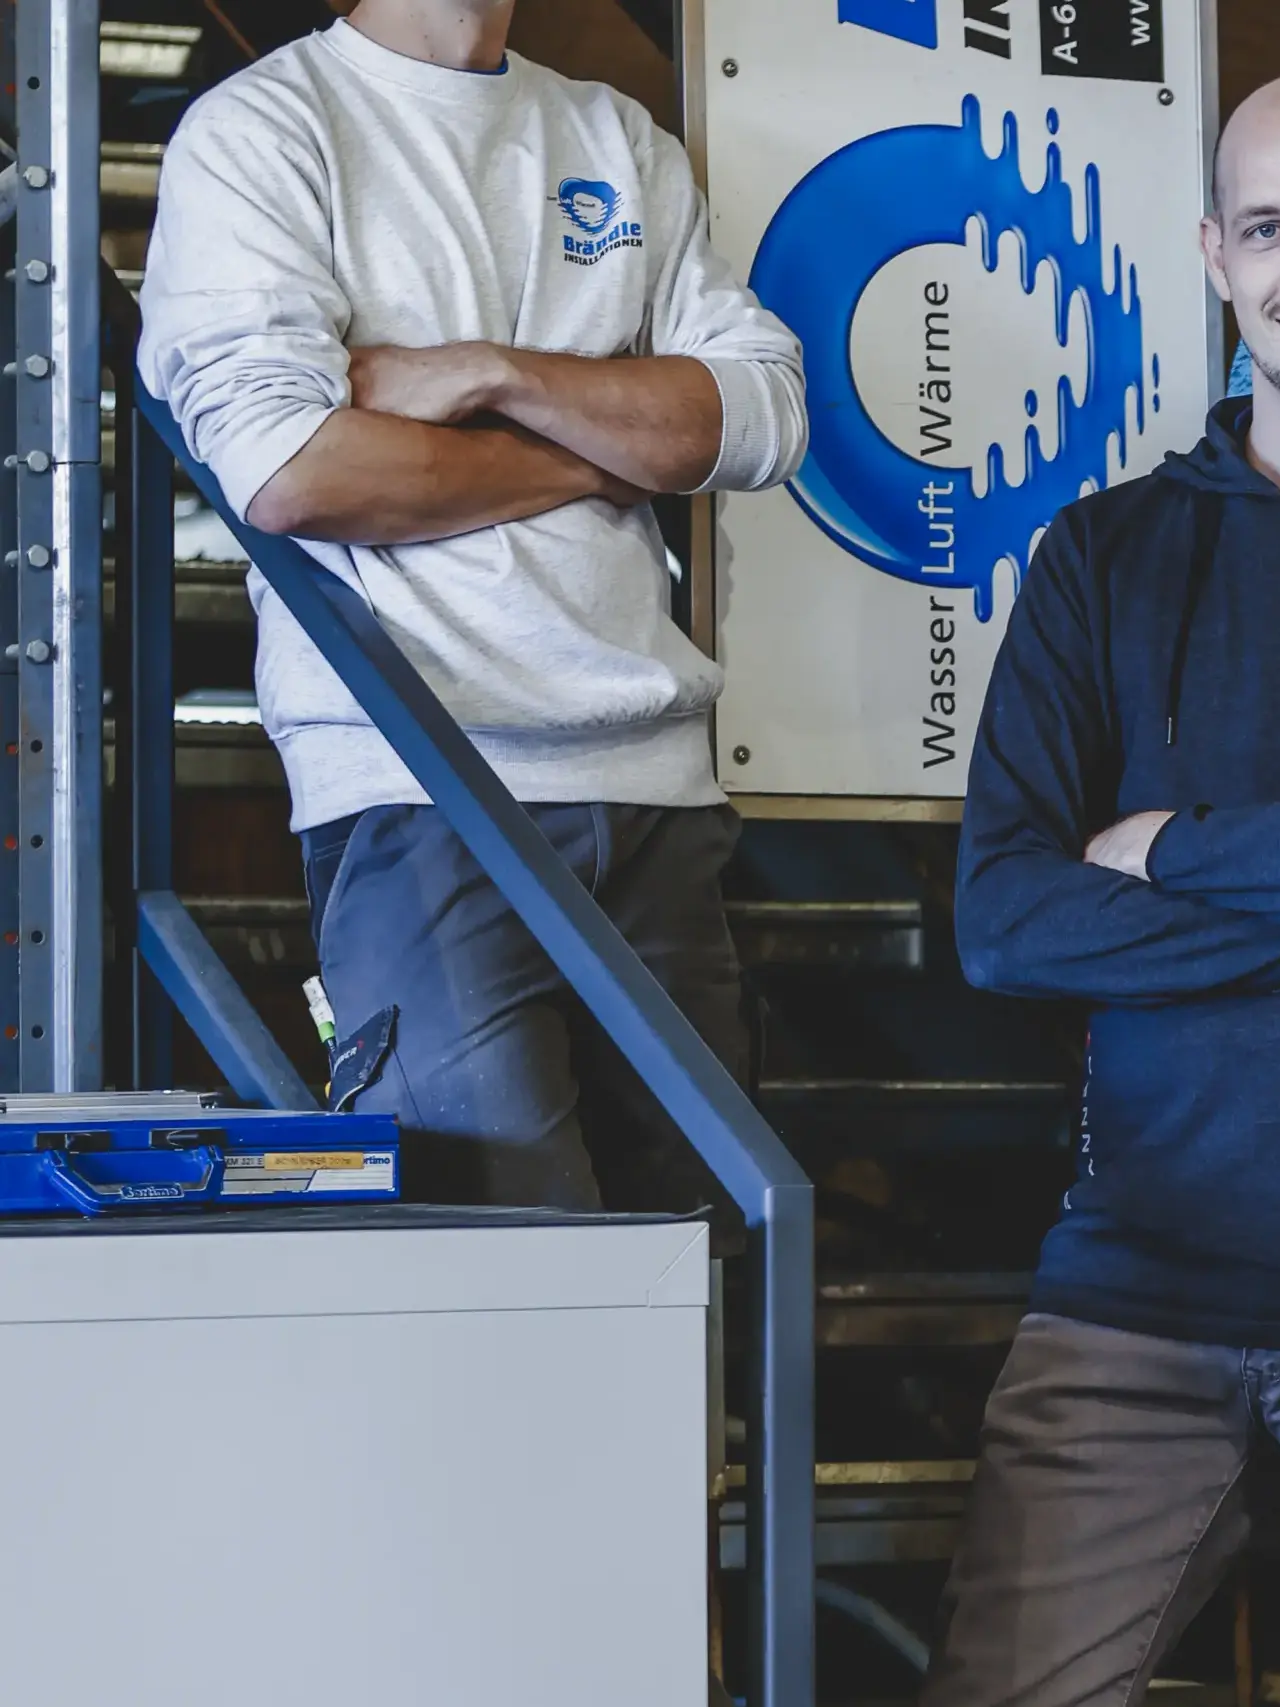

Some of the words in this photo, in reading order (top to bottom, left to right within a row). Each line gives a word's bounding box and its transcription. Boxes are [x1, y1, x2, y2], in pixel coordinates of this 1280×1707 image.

[1051, 0, 1078, 64] A-6
[563, 222, 641, 256] Brändle
[564, 238, 643, 266] INSTALLATIONEN
[919, 281, 952, 456] Wärme
[918, 481, 955, 574] Luft
[922, 595, 956, 769] Wasser
